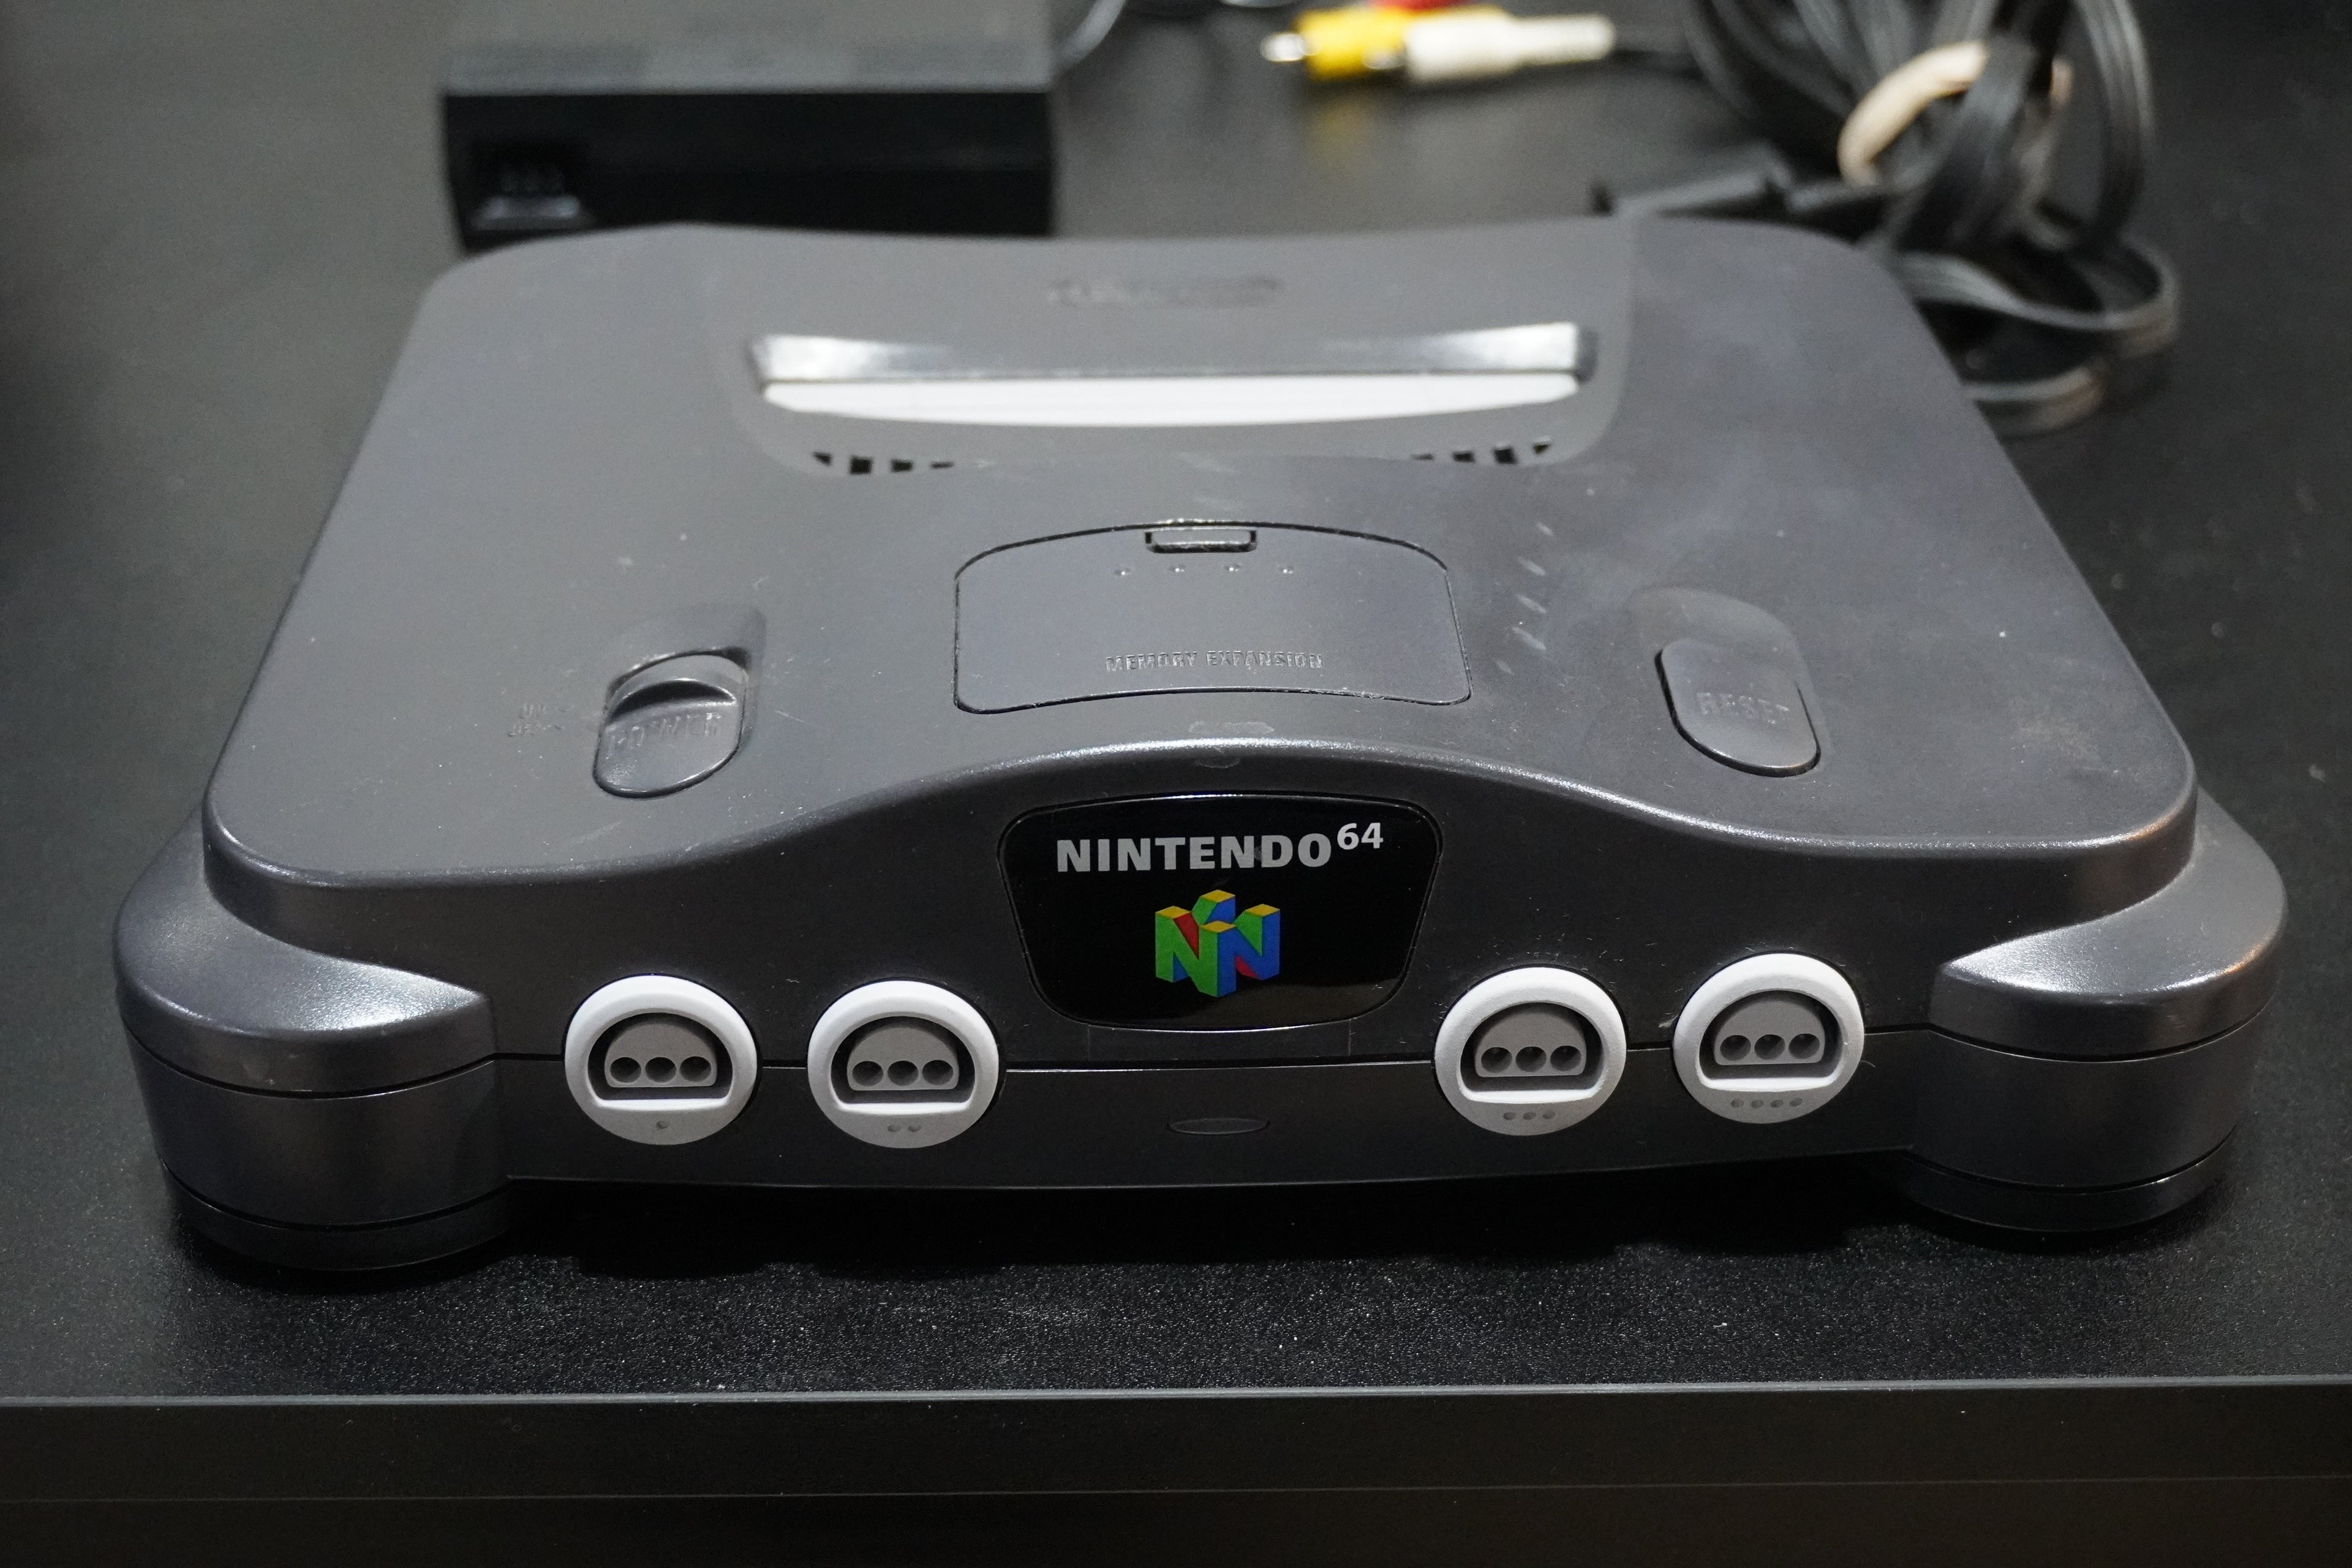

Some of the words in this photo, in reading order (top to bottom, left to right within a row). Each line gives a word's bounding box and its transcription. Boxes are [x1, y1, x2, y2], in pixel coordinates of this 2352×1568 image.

[1105, 650, 1199, 672] MEMORY
[1206, 650, 1323, 669] EXPANSION
[1057, 834, 1332, 872] NINTENDO
[1336, 822, 1384, 850] 64
